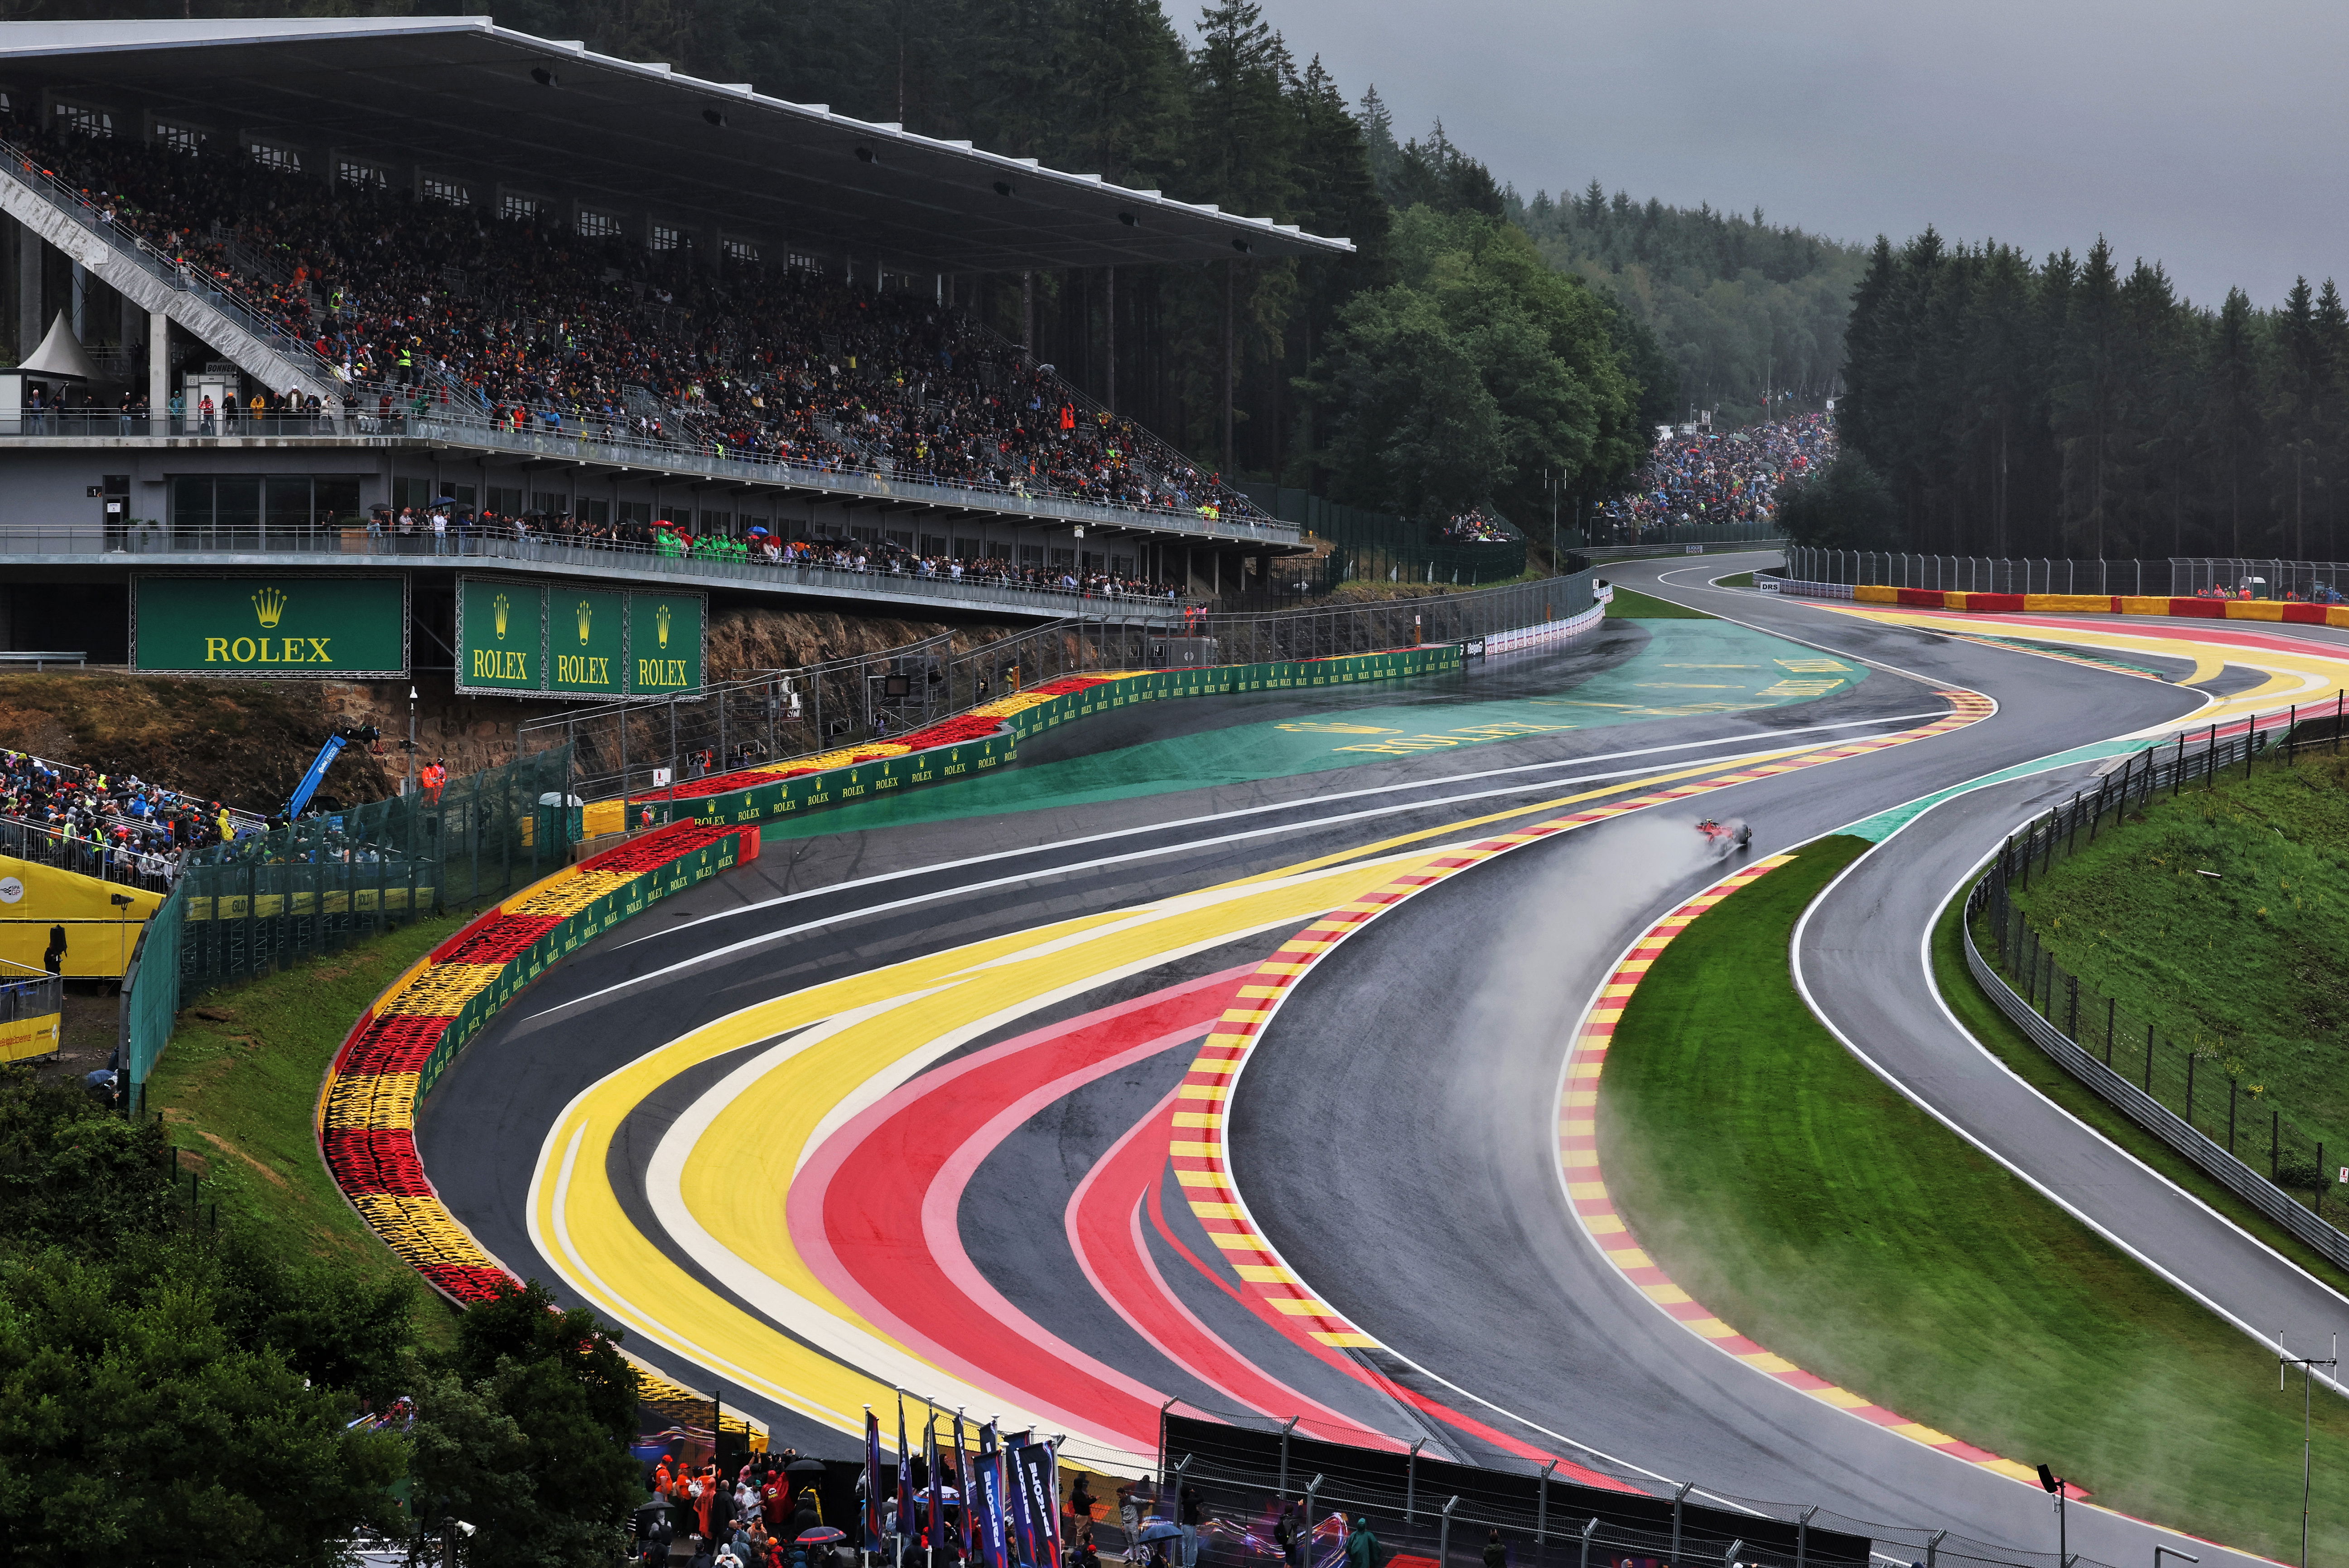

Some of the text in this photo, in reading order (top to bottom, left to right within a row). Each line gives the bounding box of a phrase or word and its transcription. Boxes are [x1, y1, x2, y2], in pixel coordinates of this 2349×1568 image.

[1486, 636, 1495, 645] LIQUI
[205, 637, 333, 662] ROLEX
[473, 650, 527, 680] ROLEX
[558, 655, 609, 684] ROLEX
[639, 659, 687, 685] ROLEX
[1129, 694, 1139, 703] ROLEX
[1142, 691, 1153, 700] ROLEX
[1173, 688, 1183, 696] ROLEX
[1097, 701, 1107, 710] ROLEX
[1114, 697, 1123, 706] ROLEX
[1064, 710, 1075, 720] ROLEX
[1081, 705, 1091, 714] ROLEX
[1033, 722, 1042, 732] ROLEX
[1049, 715, 1058, 726] ROLEX
[1332, 722, 1580, 754] ROLEX
[326, 747, 336, 758] RENTAL
[945, 763, 965, 775] ROLEX
[978, 757, 996, 768] ROLEX
[912, 771, 931, 782] ROLEX
[876, 777, 898, 790] ROLEX
[843, 785, 864, 797] ROLEX
[808, 792, 829, 805] ROLEX
[773, 800, 796, 813] ROLEX
[738, 808, 759, 821] ROLEX
[718, 855, 733, 868] ROLEX
[696, 866, 712, 880] ROLEX
[670, 876, 687, 891] ROLEX
[648, 887, 662, 902] ROLEX
[627, 899, 642, 914] ROLEX
[605, 911, 617, 926] ROLEX
[584, 923, 597, 939] ROLEX
[565, 936, 578, 951] ROLEX
[547, 948, 559, 964] ROLEX
